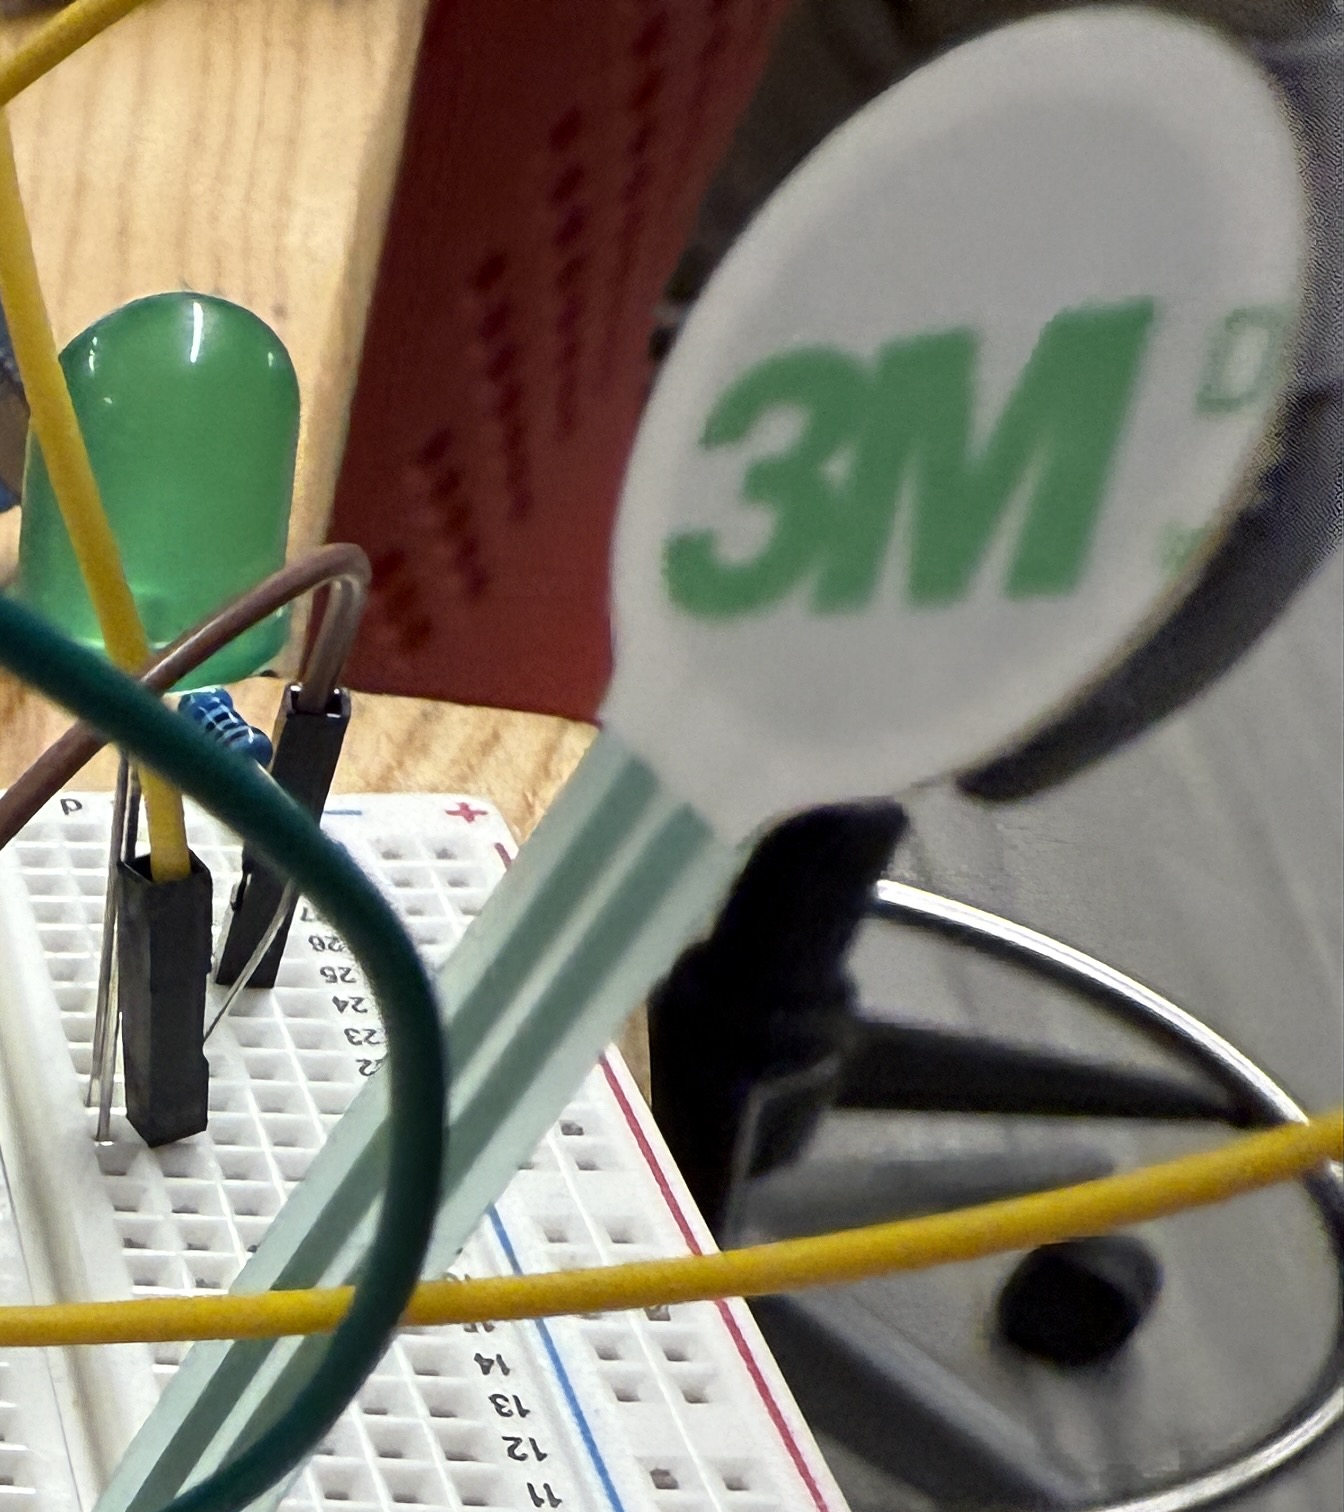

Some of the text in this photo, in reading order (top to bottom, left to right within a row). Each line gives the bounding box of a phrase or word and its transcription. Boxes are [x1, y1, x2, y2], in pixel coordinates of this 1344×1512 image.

[662, 297, 1153, 624] 3M
[473, 1353, 511, 1375] 14
[488, 1393, 531, 1418] 13
[501, 1435, 548, 1462] 12
[526, 1482, 563, 1508] 11
